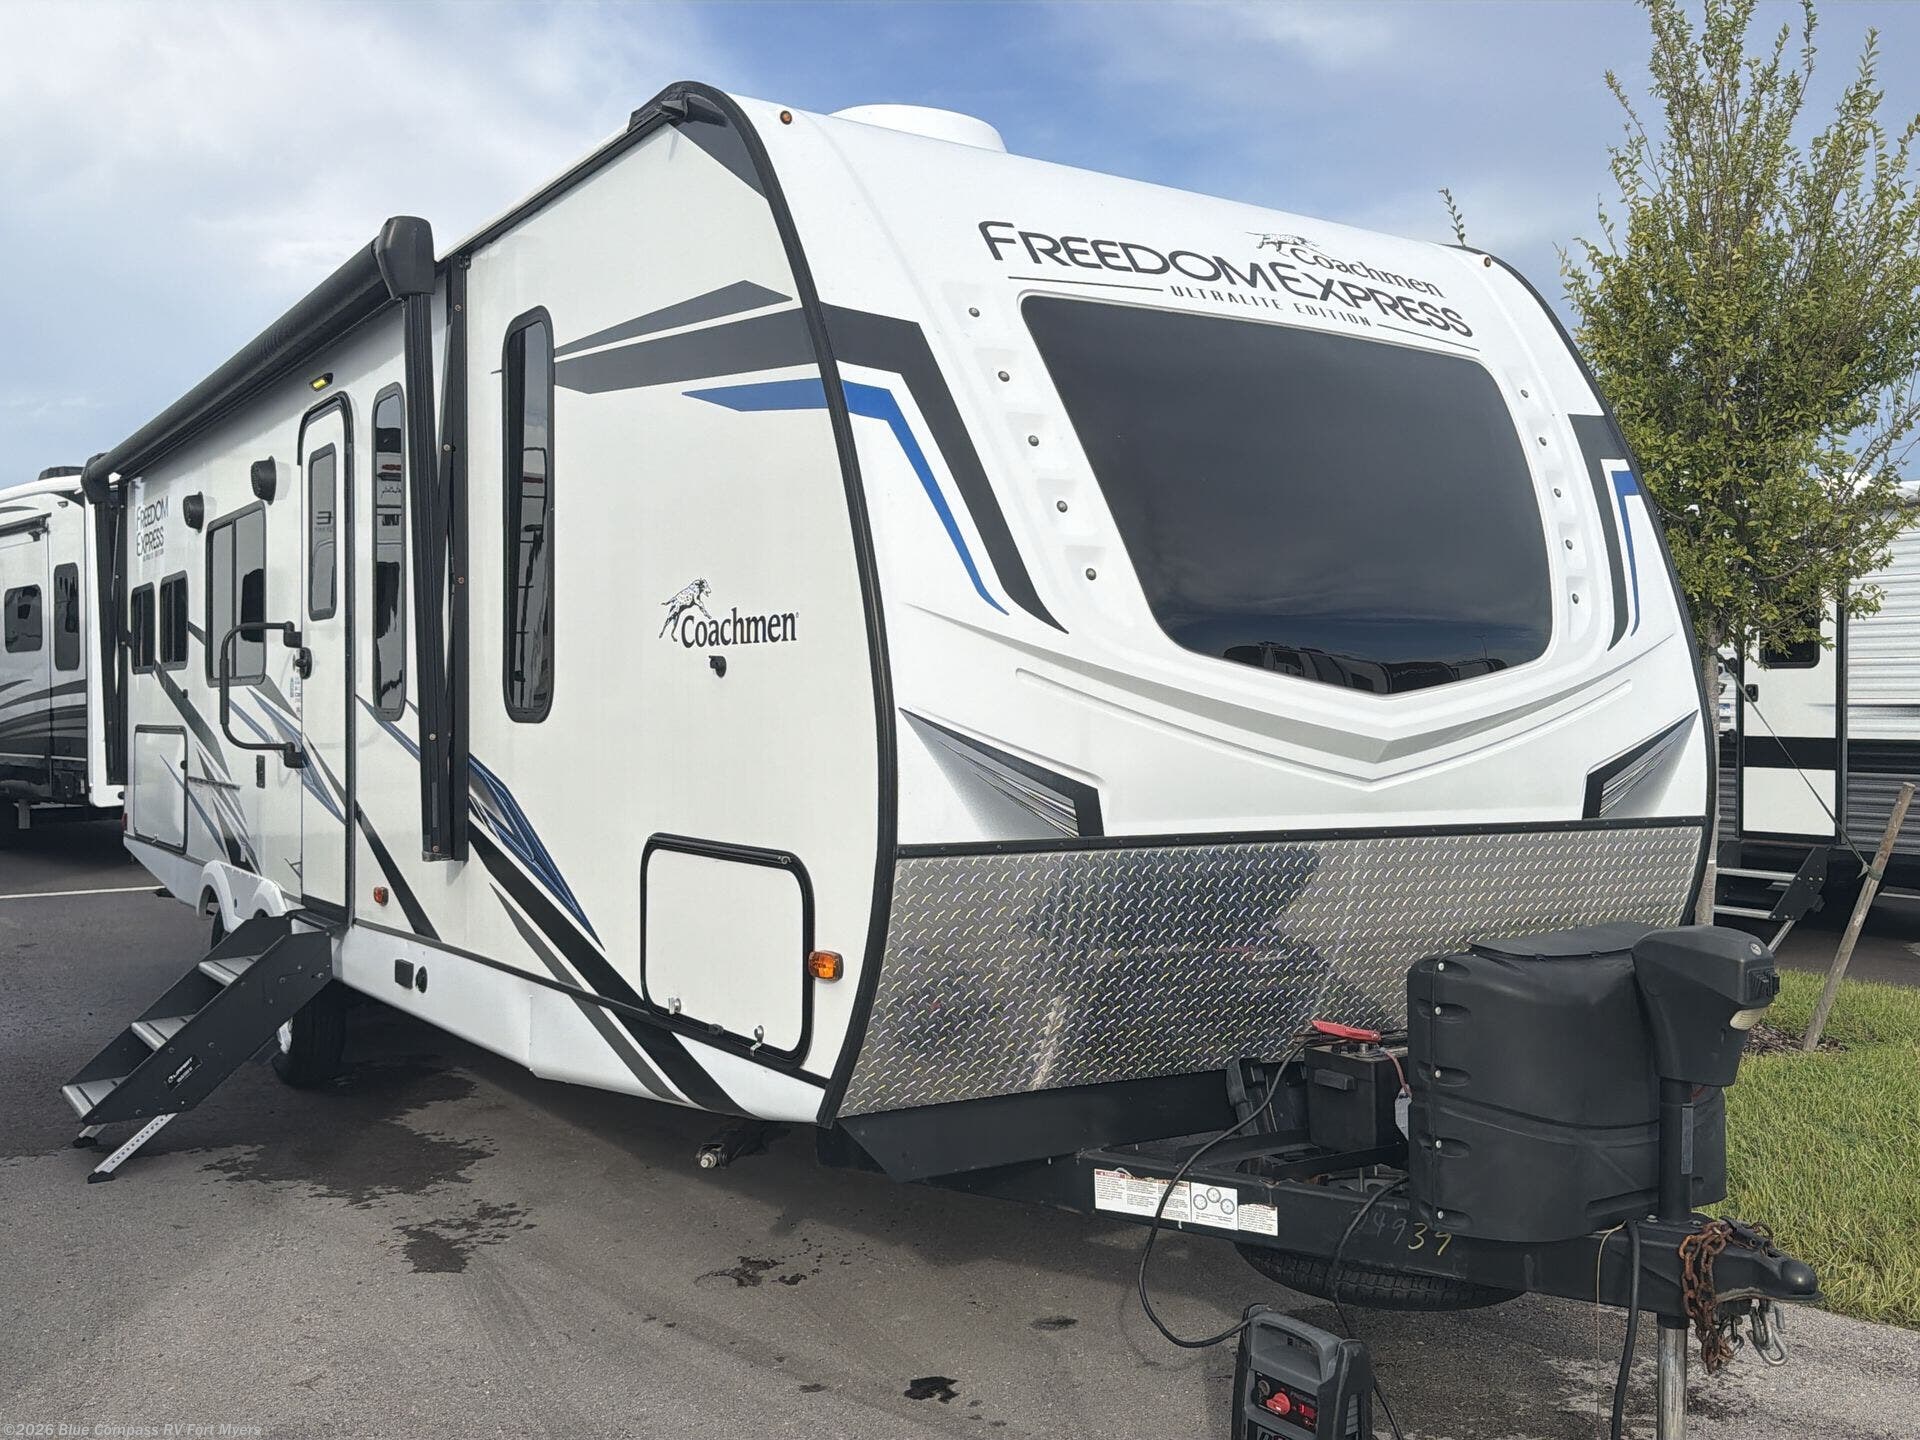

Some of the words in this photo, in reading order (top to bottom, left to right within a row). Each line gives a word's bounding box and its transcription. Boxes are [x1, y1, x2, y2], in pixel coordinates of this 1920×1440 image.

[1290, 246, 1446, 299] Coachmen
[1170, 285, 1283, 311] ULTRALITE
[1293, 302, 1372, 327] EDITION
[137, 495, 169, 531] FREEDOM
[136, 525, 165, 556] EXPRESS
[681, 607, 797, 649] Coachmen
